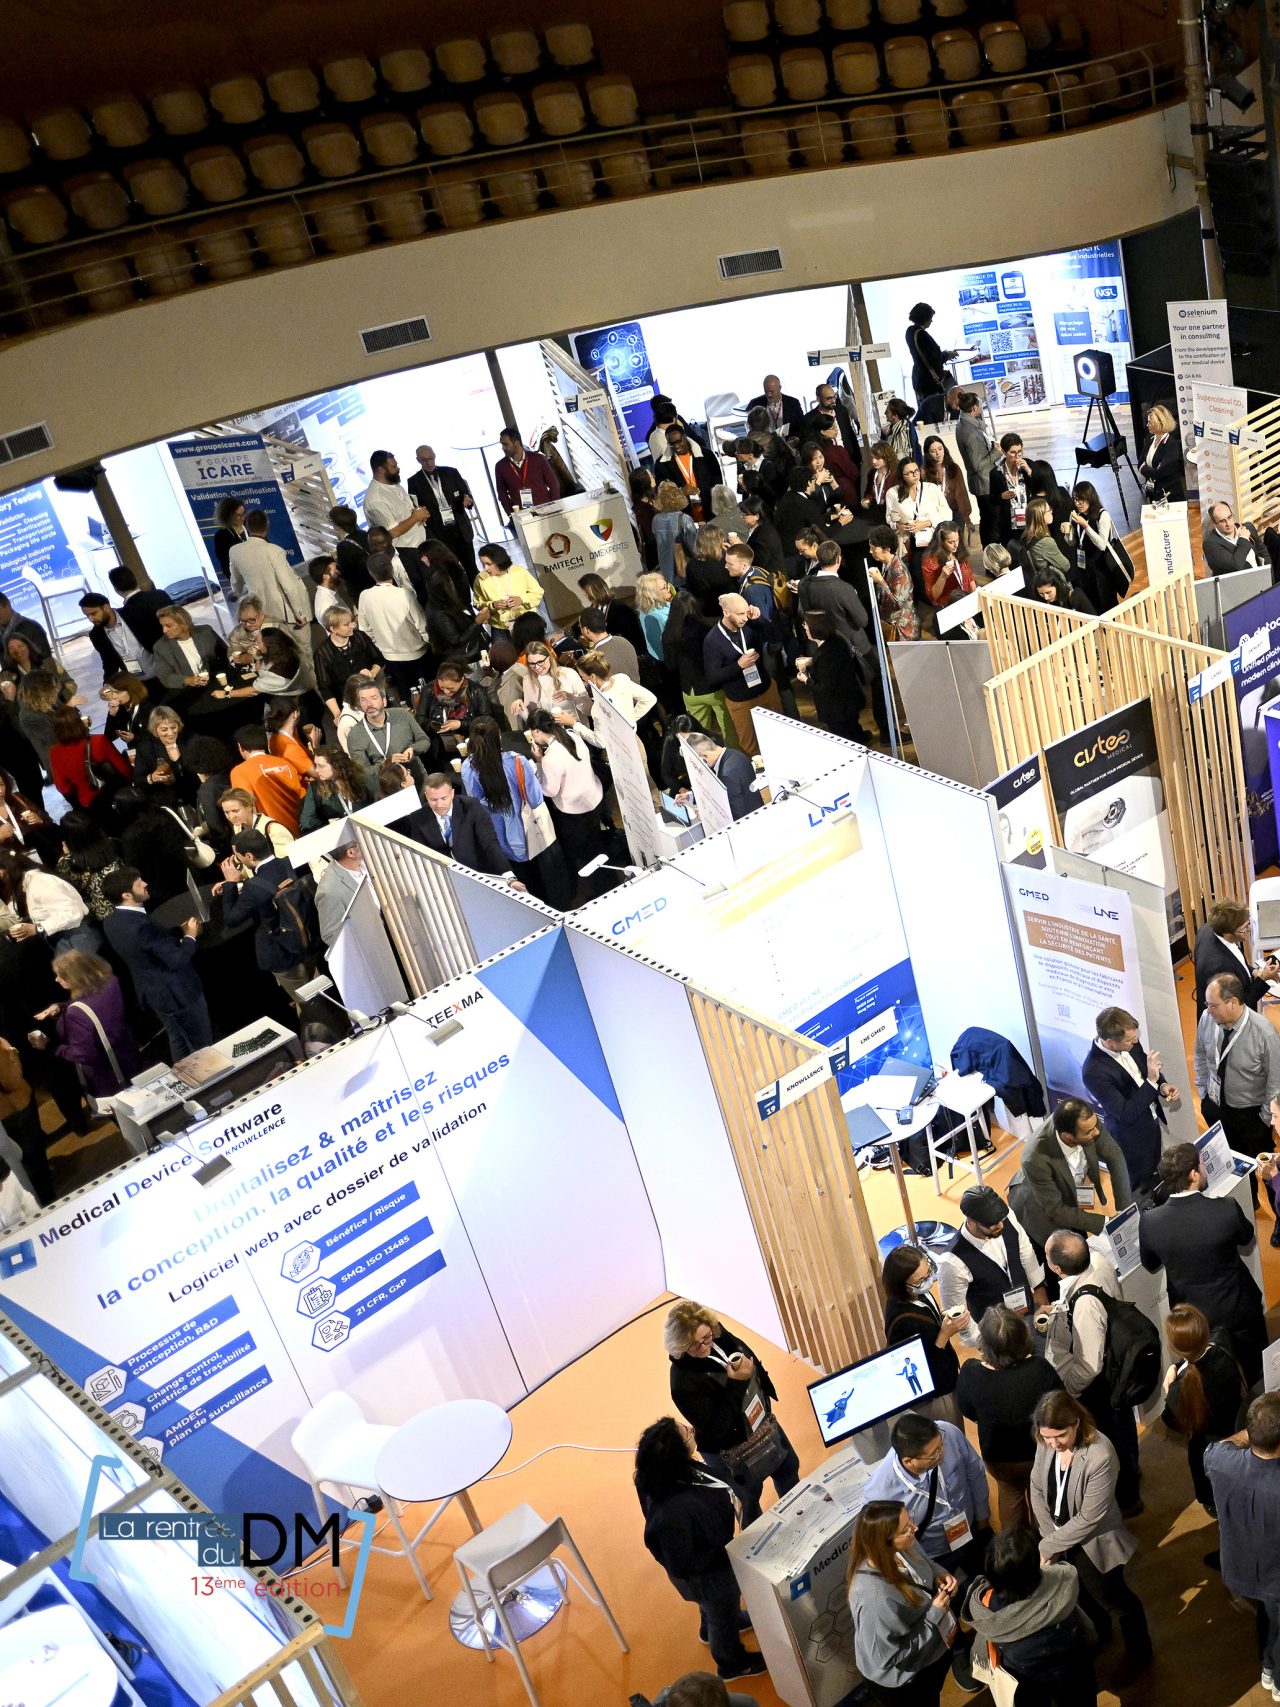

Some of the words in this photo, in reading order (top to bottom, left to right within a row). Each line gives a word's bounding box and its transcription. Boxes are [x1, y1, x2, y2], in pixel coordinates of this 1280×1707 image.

[1187, 308, 1218, 317] selenium
[1187, 332, 1221, 340] consulting
[1202, 323, 1225, 331] partner
[1196, 393, 1233, 406] Supercritical
[1209, 405, 1234, 416] Cleaning
[175, 439, 258, 454] www.groupeicare.com
[206, 454, 249, 465] GROUPE
[198, 463, 254, 480] ICARE
[12, 490, 42, 506] Testing
[191, 492, 230, 501] Validation,
[230, 486, 277, 497] Qualification
[0, 512, 25, 526] alidation
[16, 518, 51, 535] Sterilization
[23, 511, 48, 525] Cleaning
[0, 541, 30, 557] Packaging
[30, 536, 40, 544] life
[40, 530, 56, 540] circle
[12, 525, 54, 543] Transportation
[0, 554, 27, 569] Biological
[28, 544, 55, 558] Indicators
[589, 541, 629, 560] DMEXPERTS
[1163, 530, 1174, 574] anufacturer
[544, 555, 583, 573] EMITECH
[1242, 656, 1265, 674] Unified
[1241, 669, 1267, 686] modern
[1107, 744, 1133, 760] MEDICAL
[1070, 785, 1083, 796] GLOBAL
[1084, 776, 1100, 788] PARTNER
[1107, 767, 1116, 777] YOUR
[1117, 760, 1132, 772] MEDICAL
[1132, 753, 1144, 763] DEVICE
[1018, 888, 1049, 901] GMED
[612, 897, 667, 935] GMED
[1094, 906, 1119, 920] LNE
[1027, 916, 1047, 925] SERVIR
[1048, 920, 1080, 935] L'INDUSTRIE
[1089, 931, 1097, 939] LA
[1041, 926, 1069, 937] SOUTENIR
[1070, 932, 1105, 949] L'INNOVATION
[1046, 933, 1060, 941] TOUT
[1075, 947, 1085, 955] DES
[1086, 951, 1111, 964] PATIENTS
[426, 990, 484, 1027] TEEXMA
[836, 1061, 846, 1070] 29
[860, 1036, 871, 1045] LNE
[871, 1025, 886, 1039] GMED
[766, 1106, 776, 1115] 19
[786, 1065, 824, 1092] KNOWLLENCE
[318, 1131, 336, 1148] &
[340, 1070, 438, 1136] maîtrisez
[225, 1117, 287, 1156] KNOWLLENCE
[38, 1192, 121, 1248] Medical
[124, 1154, 193, 1199] Device
[198, 1103, 283, 1156] Software
[97, 1288, 122, 1310] la
[127, 1206, 267, 1292] conception,
[269, 1184, 292, 1206] la
[296, 1136, 368, 1191] qualité
[375, 1120, 396, 1143] et
[401, 1099, 435, 1126] les
[438, 1051, 511, 1105] risques
[168, 1253, 240, 1303] Logiciel
[245, 1229, 280, 1257] web
[283, 1203, 322, 1233] avec
[326, 1162, 386, 1207] dossier
[389, 1150, 409, 1170] de
[325, 1218, 368, 1247] Bénéfice
[370, 1212, 373, 1221] /
[374, 1193, 406, 1216] Risque
[340, 1265, 366, 1283] SMQ,
[366, 1254, 383, 1266] ISO
[383, 1235, 410, 1255] 13485
[356, 1307, 365, 1316] 21
[366, 1292, 388, 1308] CFR,
[388, 1278, 407, 1292] GxP
[127, 1330, 182, 1367] Processus
[182, 1320, 197, 1332] de
[132, 1335, 195, 1376] conception,
[195, 1317, 219, 1336] R&D
[146, 1377, 184, 1403] Change
[185, 1352, 223, 1378] control,
[151, 1384, 189, 1412] matrice
[189, 1376, 202, 1386] de
[202, 1343, 252, 1381] traçabilité
[164, 1408, 207, 1438] AMDEC,
[169, 1427, 193, 1448] plan
[194, 1417, 207, 1429] de
[208, 1377, 268, 1420] surveillance
